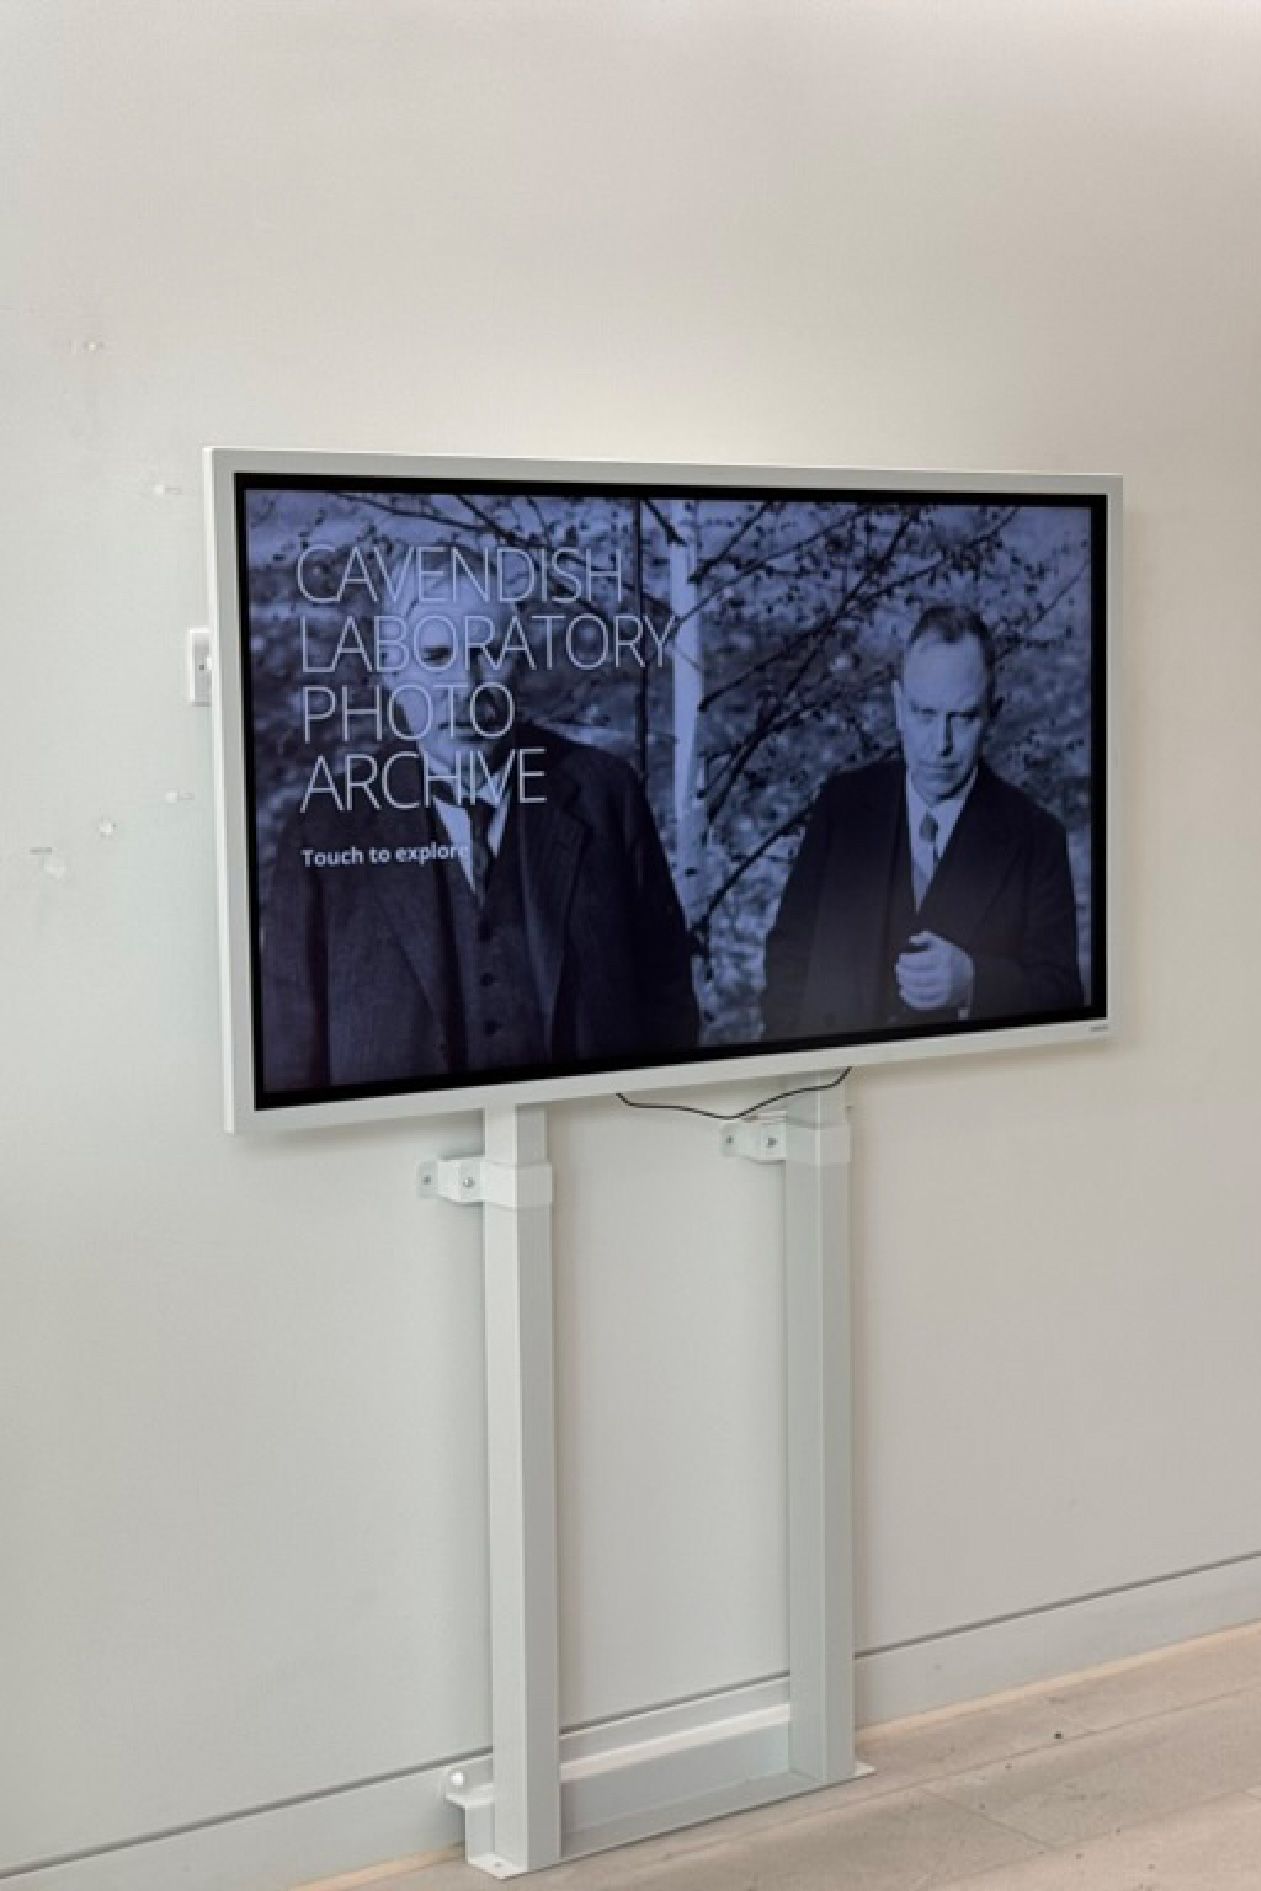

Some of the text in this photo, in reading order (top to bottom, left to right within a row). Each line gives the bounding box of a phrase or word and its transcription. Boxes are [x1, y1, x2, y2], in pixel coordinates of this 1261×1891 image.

[296, 543, 623, 604] CAVENDISH
[300, 615, 676, 674] LABORATORY
[302, 681, 516, 744] PHOTO
[300, 747, 547, 814] ARCHIVE
[300, 846, 363, 868] Touch
[369, 847, 390, 863] to
